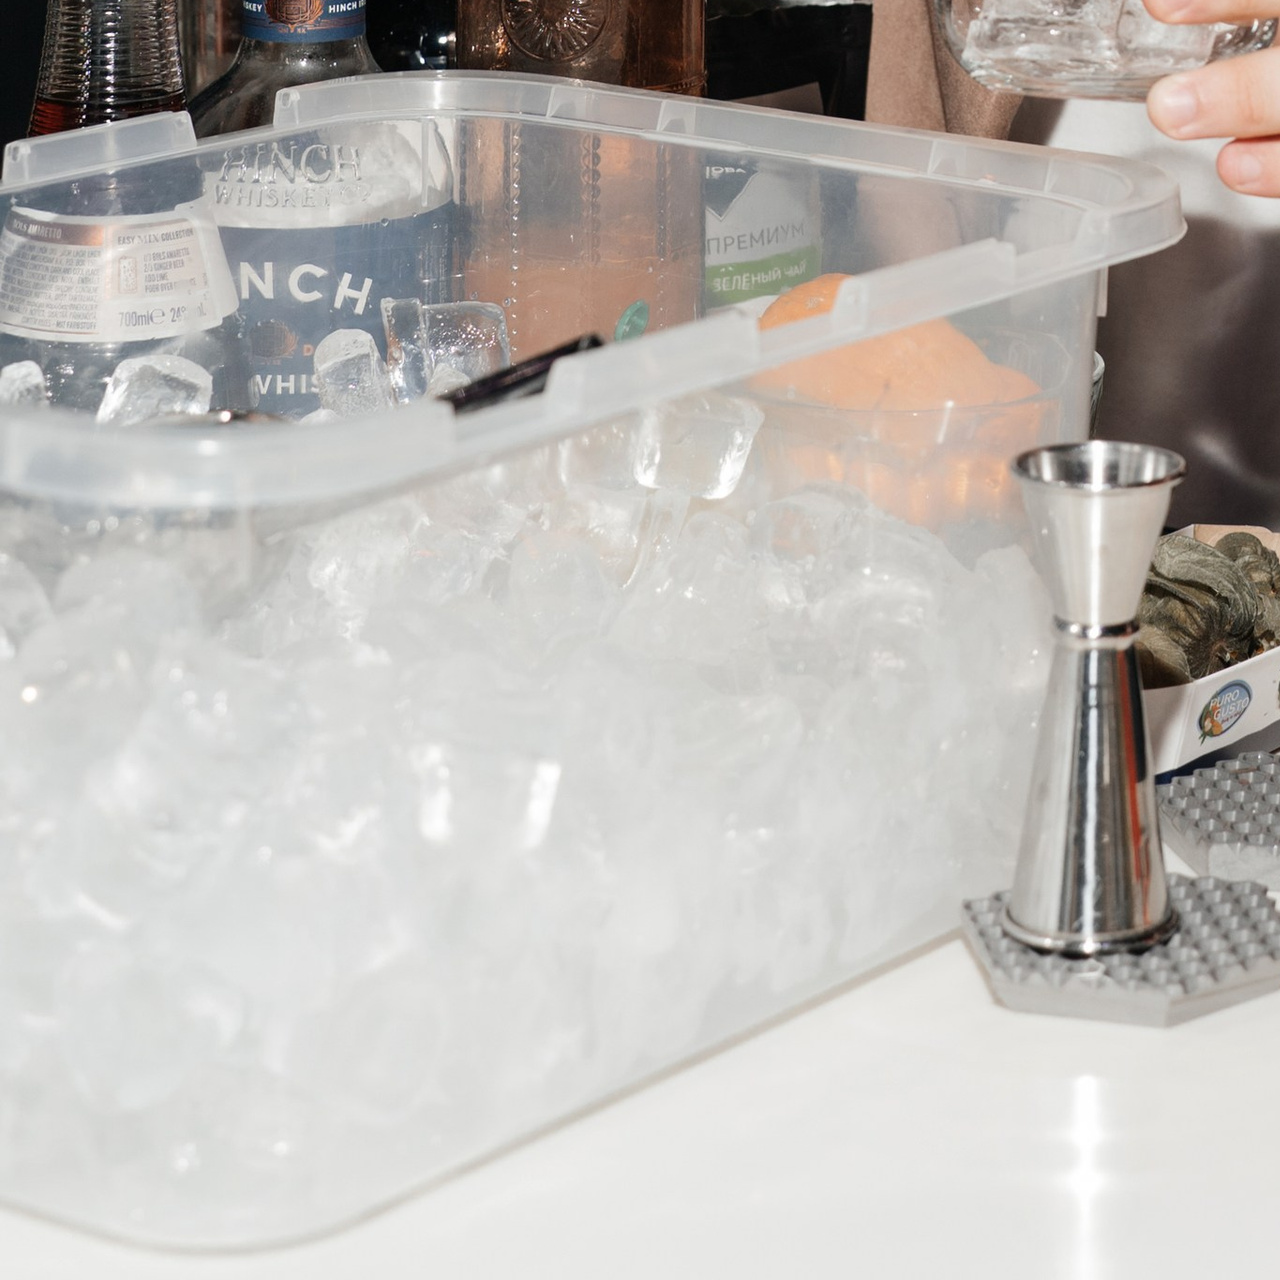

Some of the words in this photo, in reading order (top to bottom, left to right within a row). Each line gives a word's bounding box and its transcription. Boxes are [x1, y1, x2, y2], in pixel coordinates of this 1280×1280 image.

[328, 1, 357, 14] HINCH
[219, 142, 362, 184] HINCH
[117, 235, 135, 246] EASY
[161, 227, 194, 242] COLLECTION
[706, 223, 805, 256] ПРЕМИУМ
[239, 261, 373, 316] NCH
[1209, 689, 1239, 710] PURO
[1214, 696, 1250, 720] GUSTO
